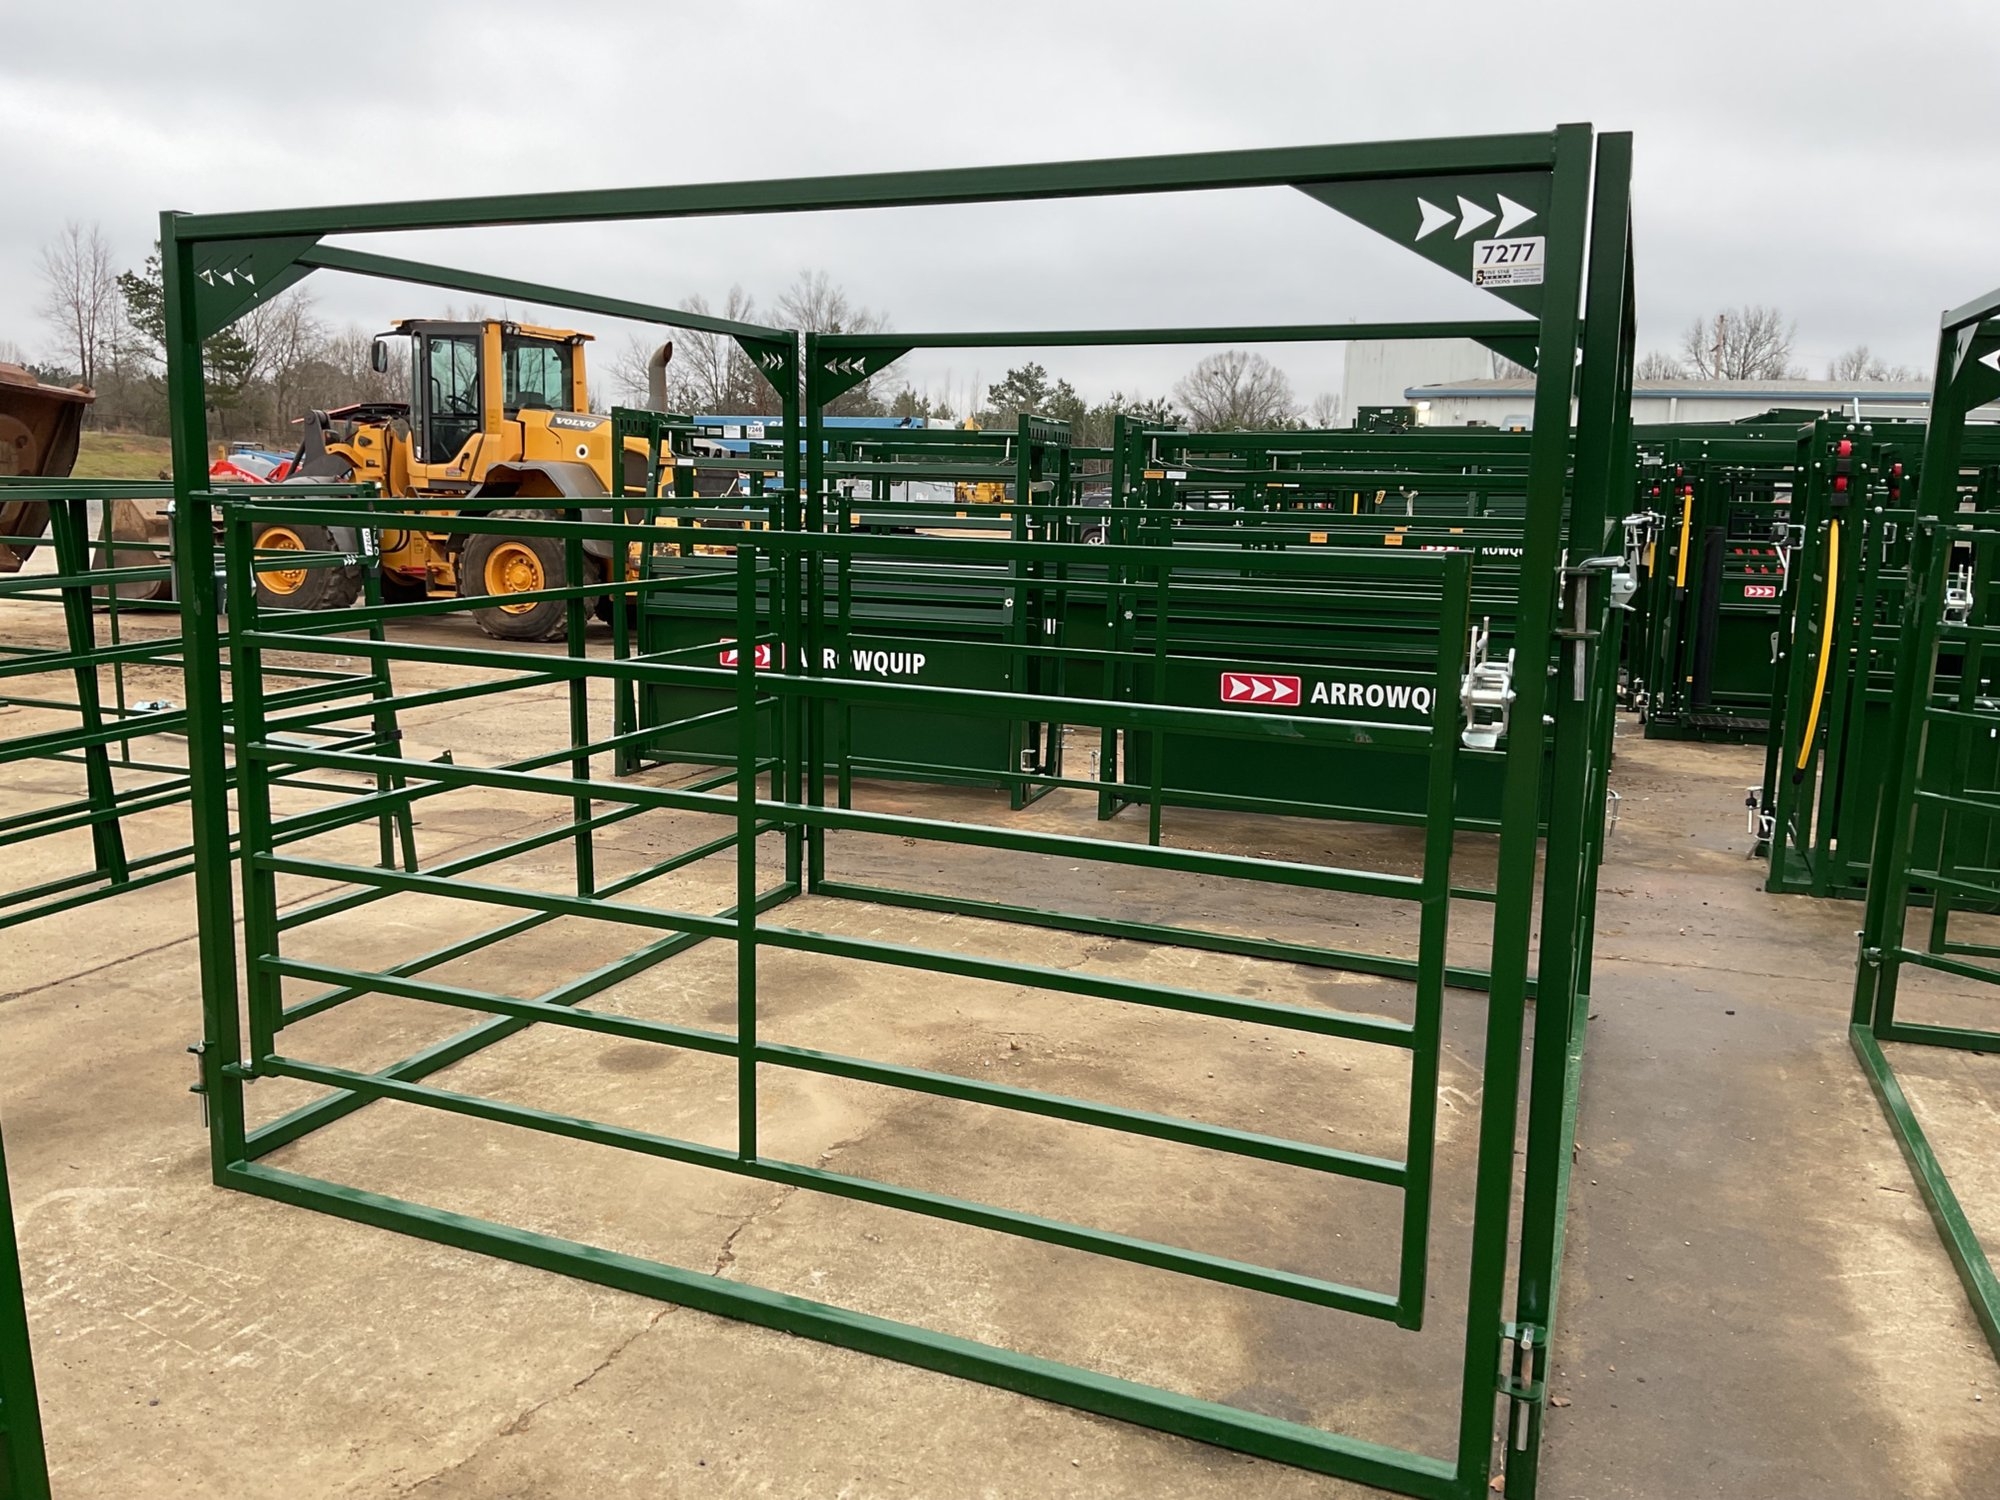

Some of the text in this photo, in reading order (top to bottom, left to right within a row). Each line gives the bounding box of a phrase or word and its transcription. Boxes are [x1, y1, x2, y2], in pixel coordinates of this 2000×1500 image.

[1482, 243, 1536, 264] 7277
[556, 417, 597, 428] VOLVO
[1310, 681, 1437, 714] ARROWQ
